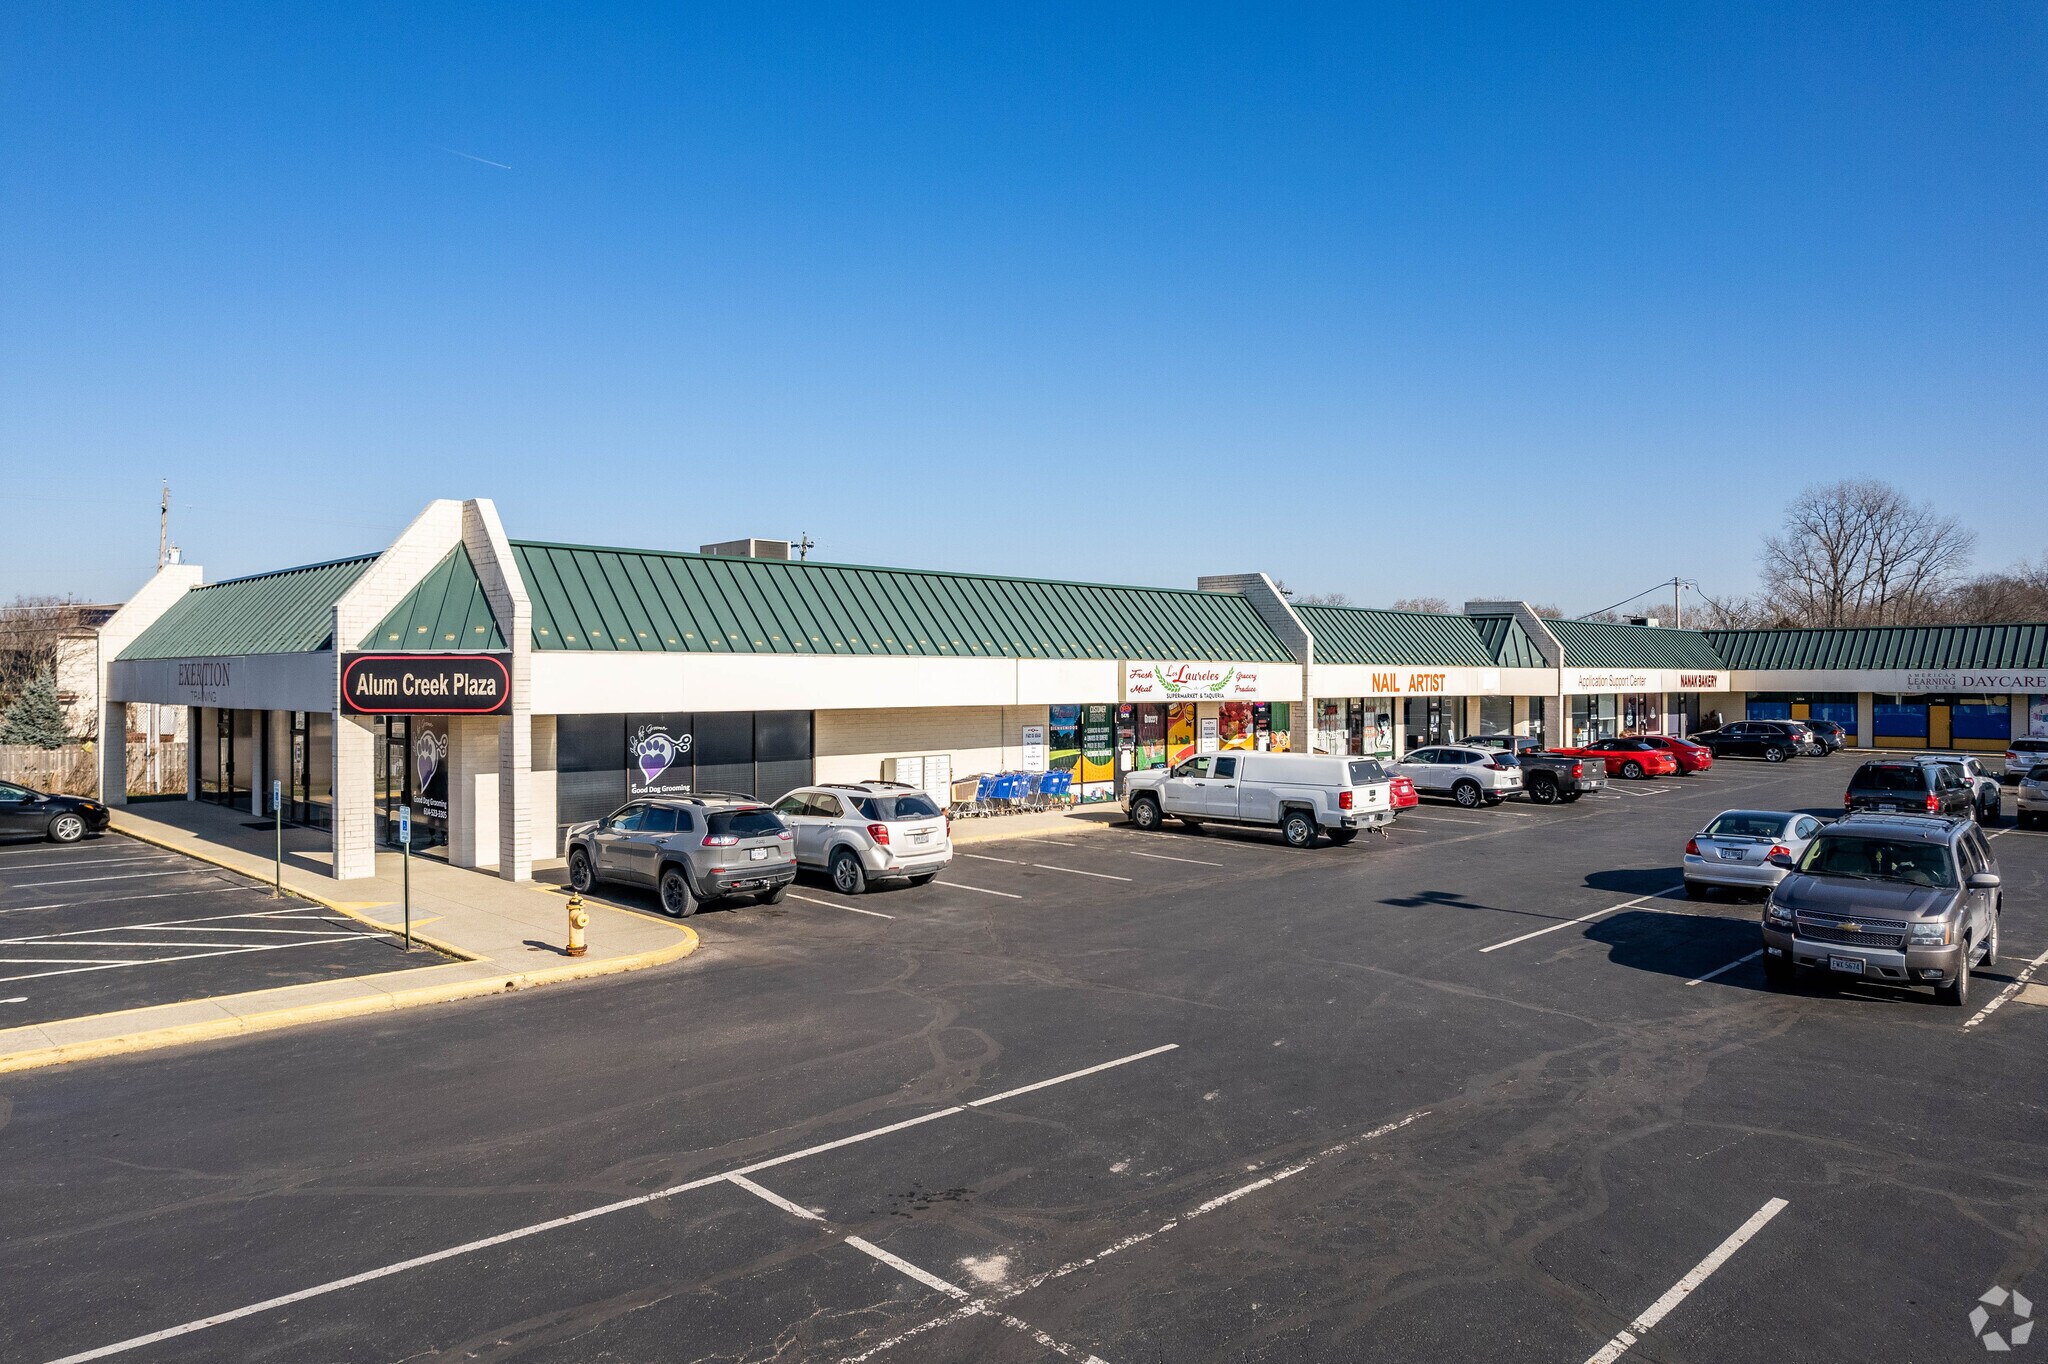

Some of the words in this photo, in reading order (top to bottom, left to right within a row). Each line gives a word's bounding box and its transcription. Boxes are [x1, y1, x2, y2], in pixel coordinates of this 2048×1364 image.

[178, 662, 230, 687] EXERTION
[1129, 669, 1153, 680] Fresh
[1165, 665, 1178, 677] Los
[1172, 664, 1219, 684] Laureles
[1235, 671, 1257, 682] Grocery
[355, 673, 398, 696] Alum
[402, 673, 449, 696] Creek
[453, 673, 497, 696] Plaza
[1372, 672, 1400, 692] NAIL
[1408, 673, 1445, 692] ARTIST
[1578, 675, 1608, 690] Application
[1609, 674, 1629, 689] Support
[1629, 675, 1646, 687] Center
[1680, 675, 1698, 688] NANAK
[1698, 675, 1717, 687] BAKERY
[1962, 676, 2047, 687] DAYCARE
[1130, 685, 1153, 693] Meat
[1234, 685, 1257, 693] Produce
[661, 784, 690, 792] Grooming
[413, 795, 423, 804] Good
[430, 798, 447, 810] Grooming
